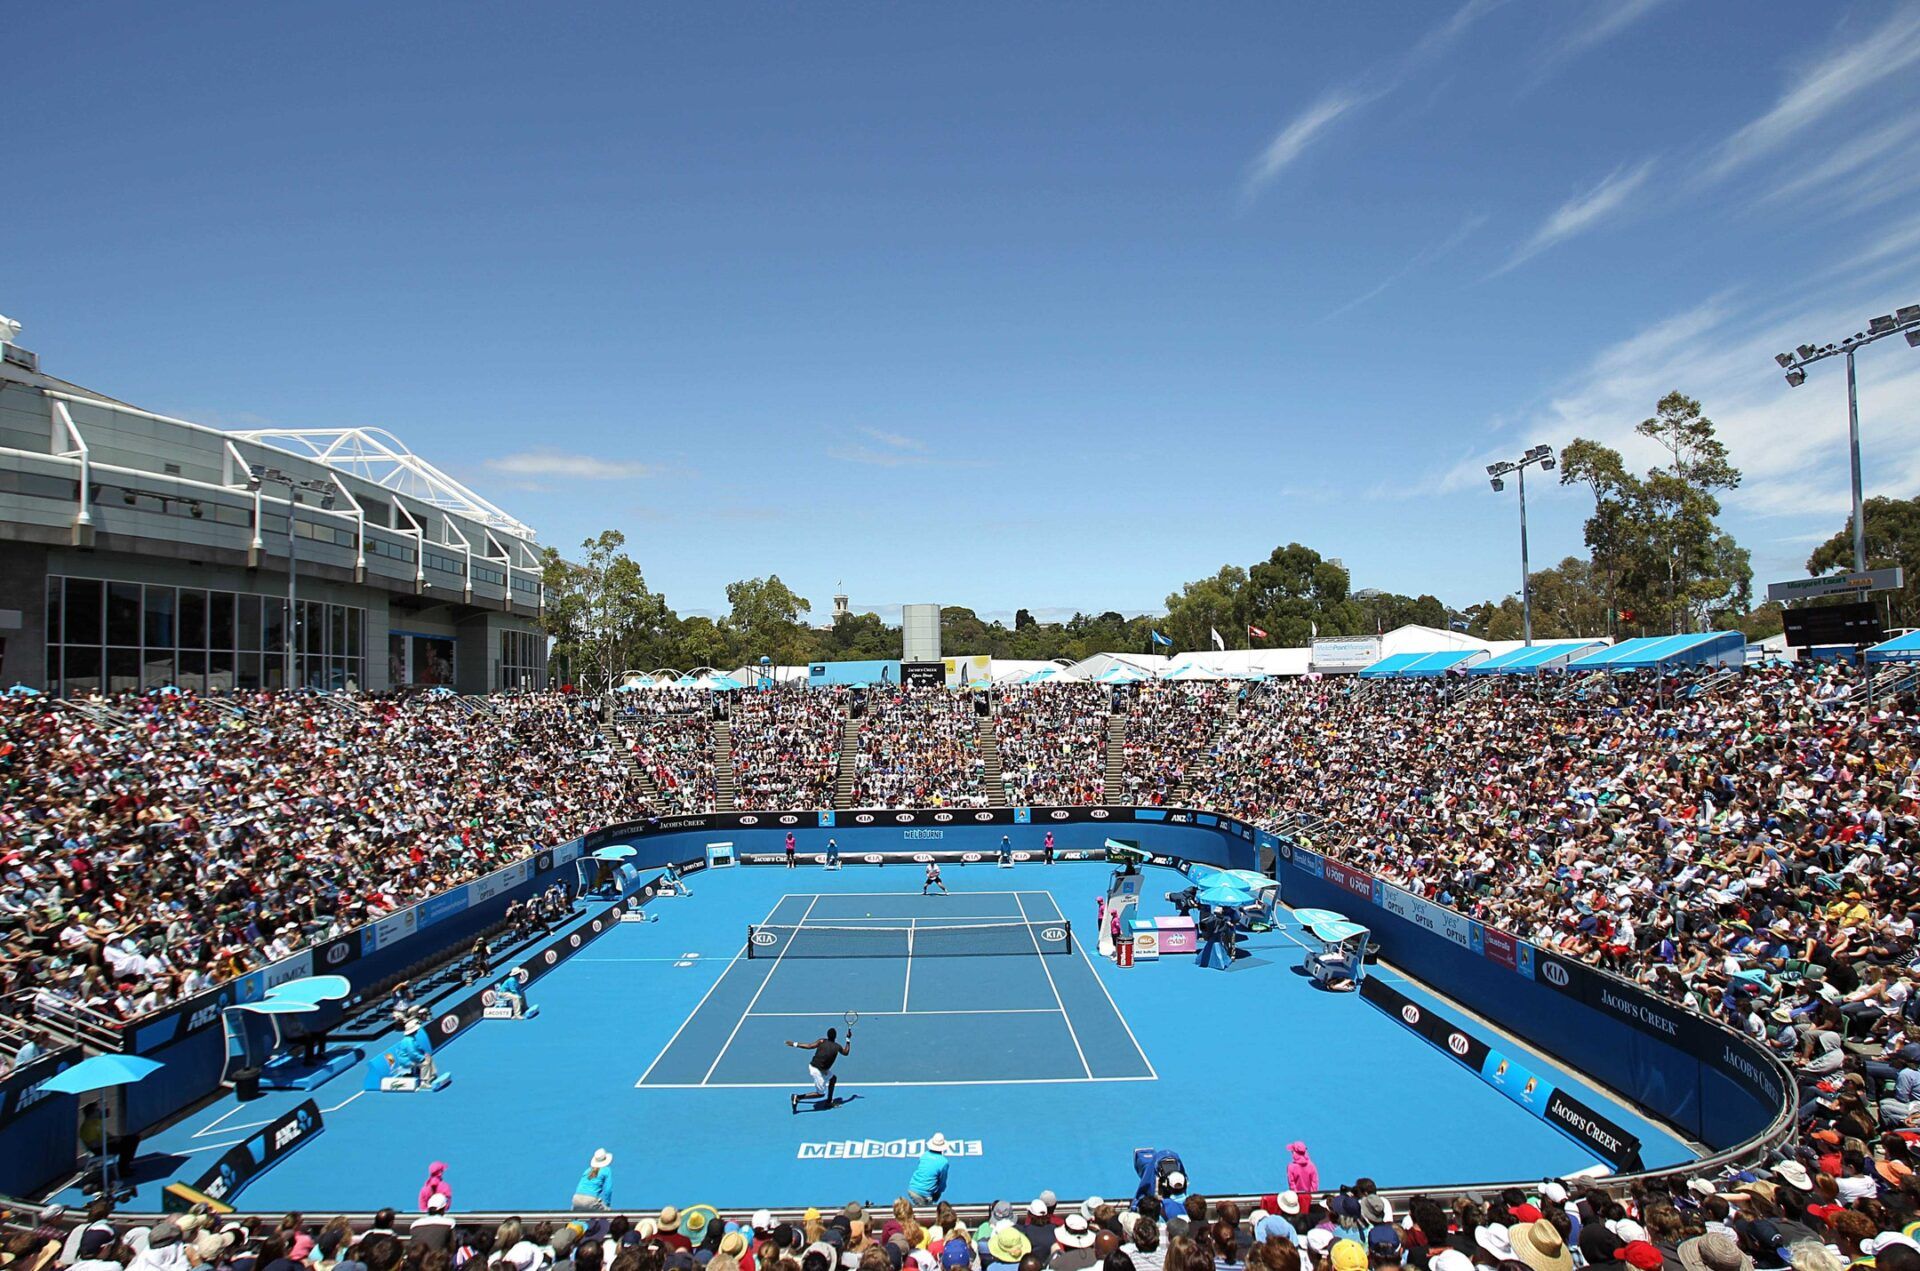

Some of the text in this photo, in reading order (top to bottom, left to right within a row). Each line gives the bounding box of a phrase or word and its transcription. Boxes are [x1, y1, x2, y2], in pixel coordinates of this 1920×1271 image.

[660, 821, 682, 829] JACOB'S
[1171, 814, 1186, 823] ANZ
[904, 830, 943, 839] MELBOURNE
[1331, 869, 1344, 885] POST
[1355, 880, 1370, 895] POST
[1388, 901, 1405, 916] OPTUS
[1415, 914, 1434, 929] OPTUS
[755, 936, 772, 944] KIA
[1045, 931, 1063, 939] KIA
[1446, 928, 1467, 945] OPTUS
[329, 945, 347, 961] KIA
[268, 964, 306, 988] LUMIX
[1545, 963, 1567, 984] KIA
[187, 1003, 217, 1032] ANZ
[1403, 1006, 1418, 1022] KIA
[1601, 989, 1676, 1037] JACOB'S CREEK
[443, 1017, 458, 1032] KIA
[1451, 1034, 1466, 1054] KIA
[1723, 1045, 1759, 1083] JACOB'S
[1552, 1099, 1617, 1153] JACOB'S CREEK
[275, 1119, 302, 1151] ANZ
[803, 1141, 979, 1157] MELBOUNE
